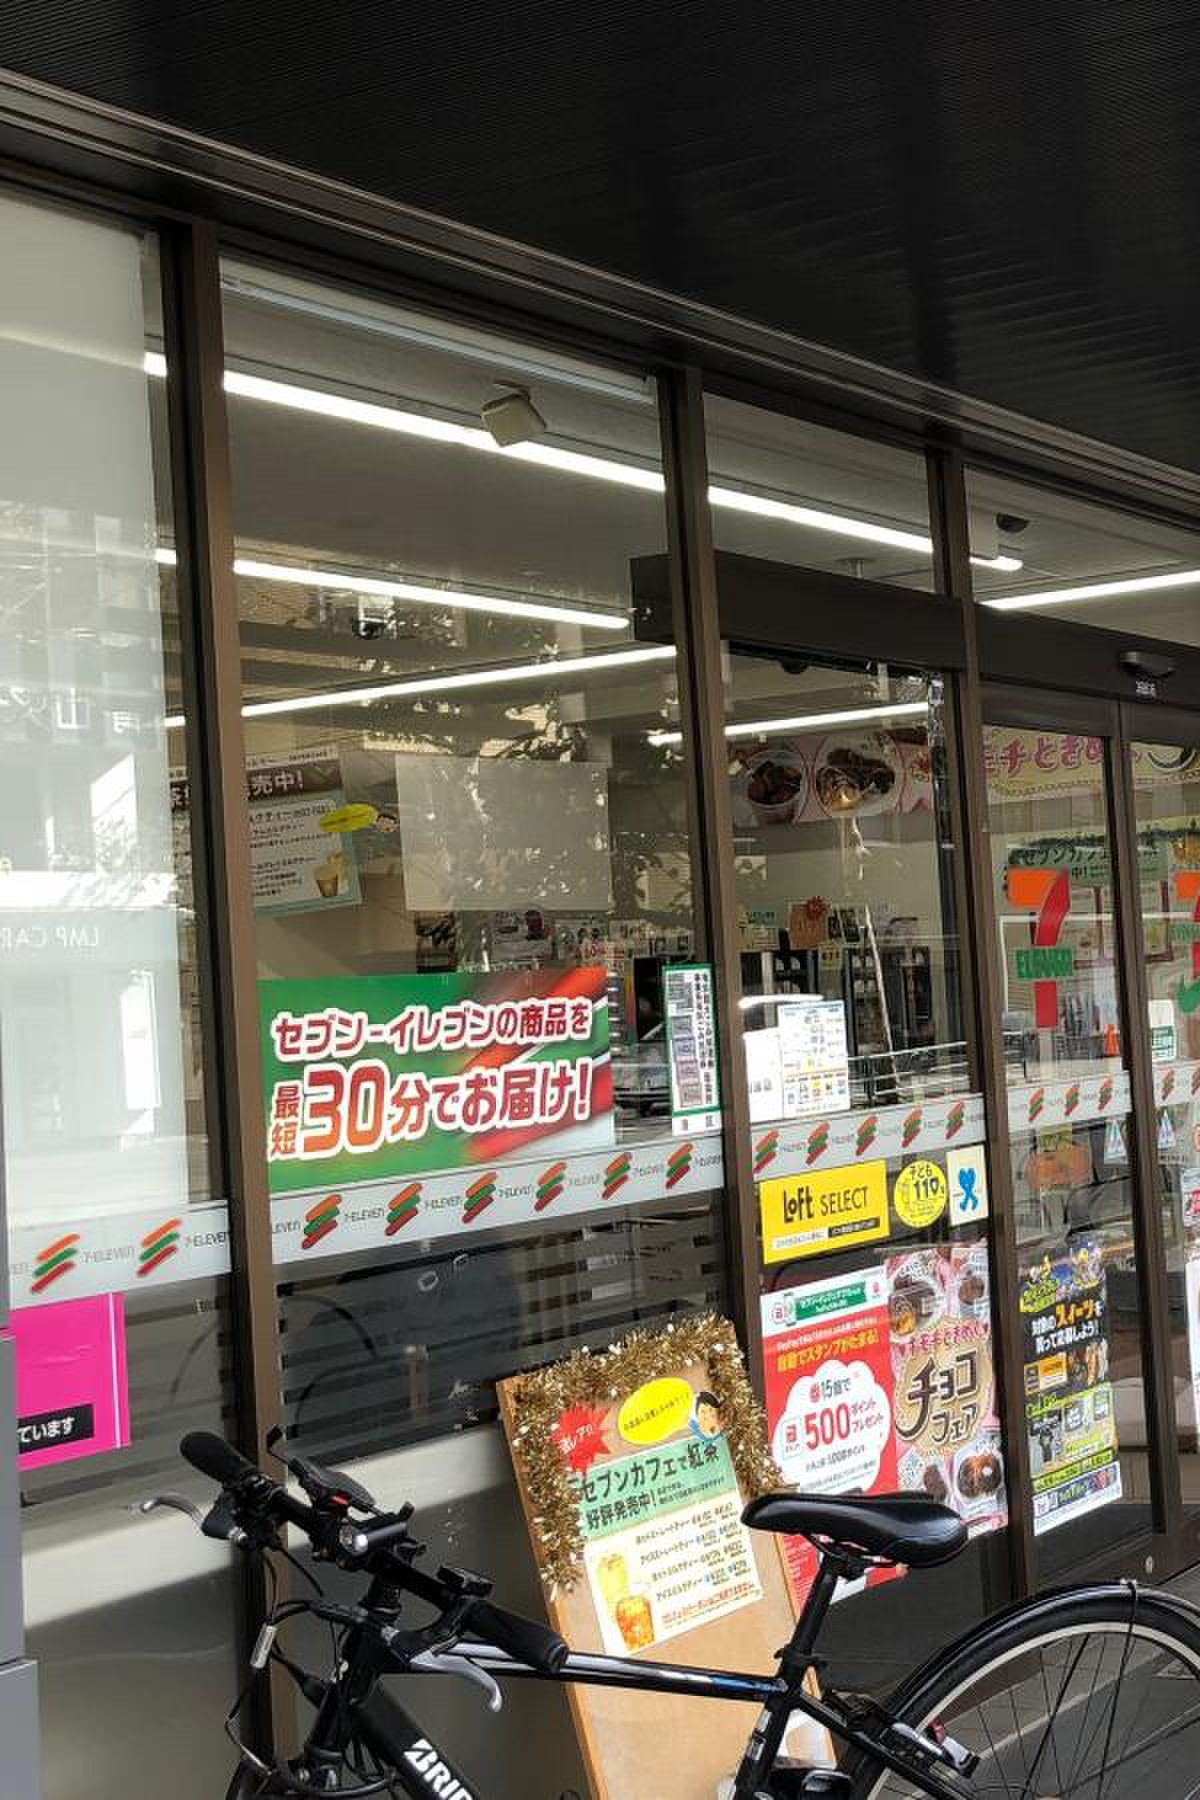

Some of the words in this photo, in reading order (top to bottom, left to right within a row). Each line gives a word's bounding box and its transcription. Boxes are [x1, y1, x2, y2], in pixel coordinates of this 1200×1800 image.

[274, 1003, 590, 1057] セブン-イレブンの商品を
[273, 1083, 300, 1156] 最短
[301, 1057, 591, 1156] 30分でお届け!
[819, 1186, 869, 1217] SELECT
[896, 1349, 977, 1438] チョコ
[18, 1416, 77, 1444] ています
[803, 1402, 851, 1451] 500
[931, 1403, 978, 1443] フェア
